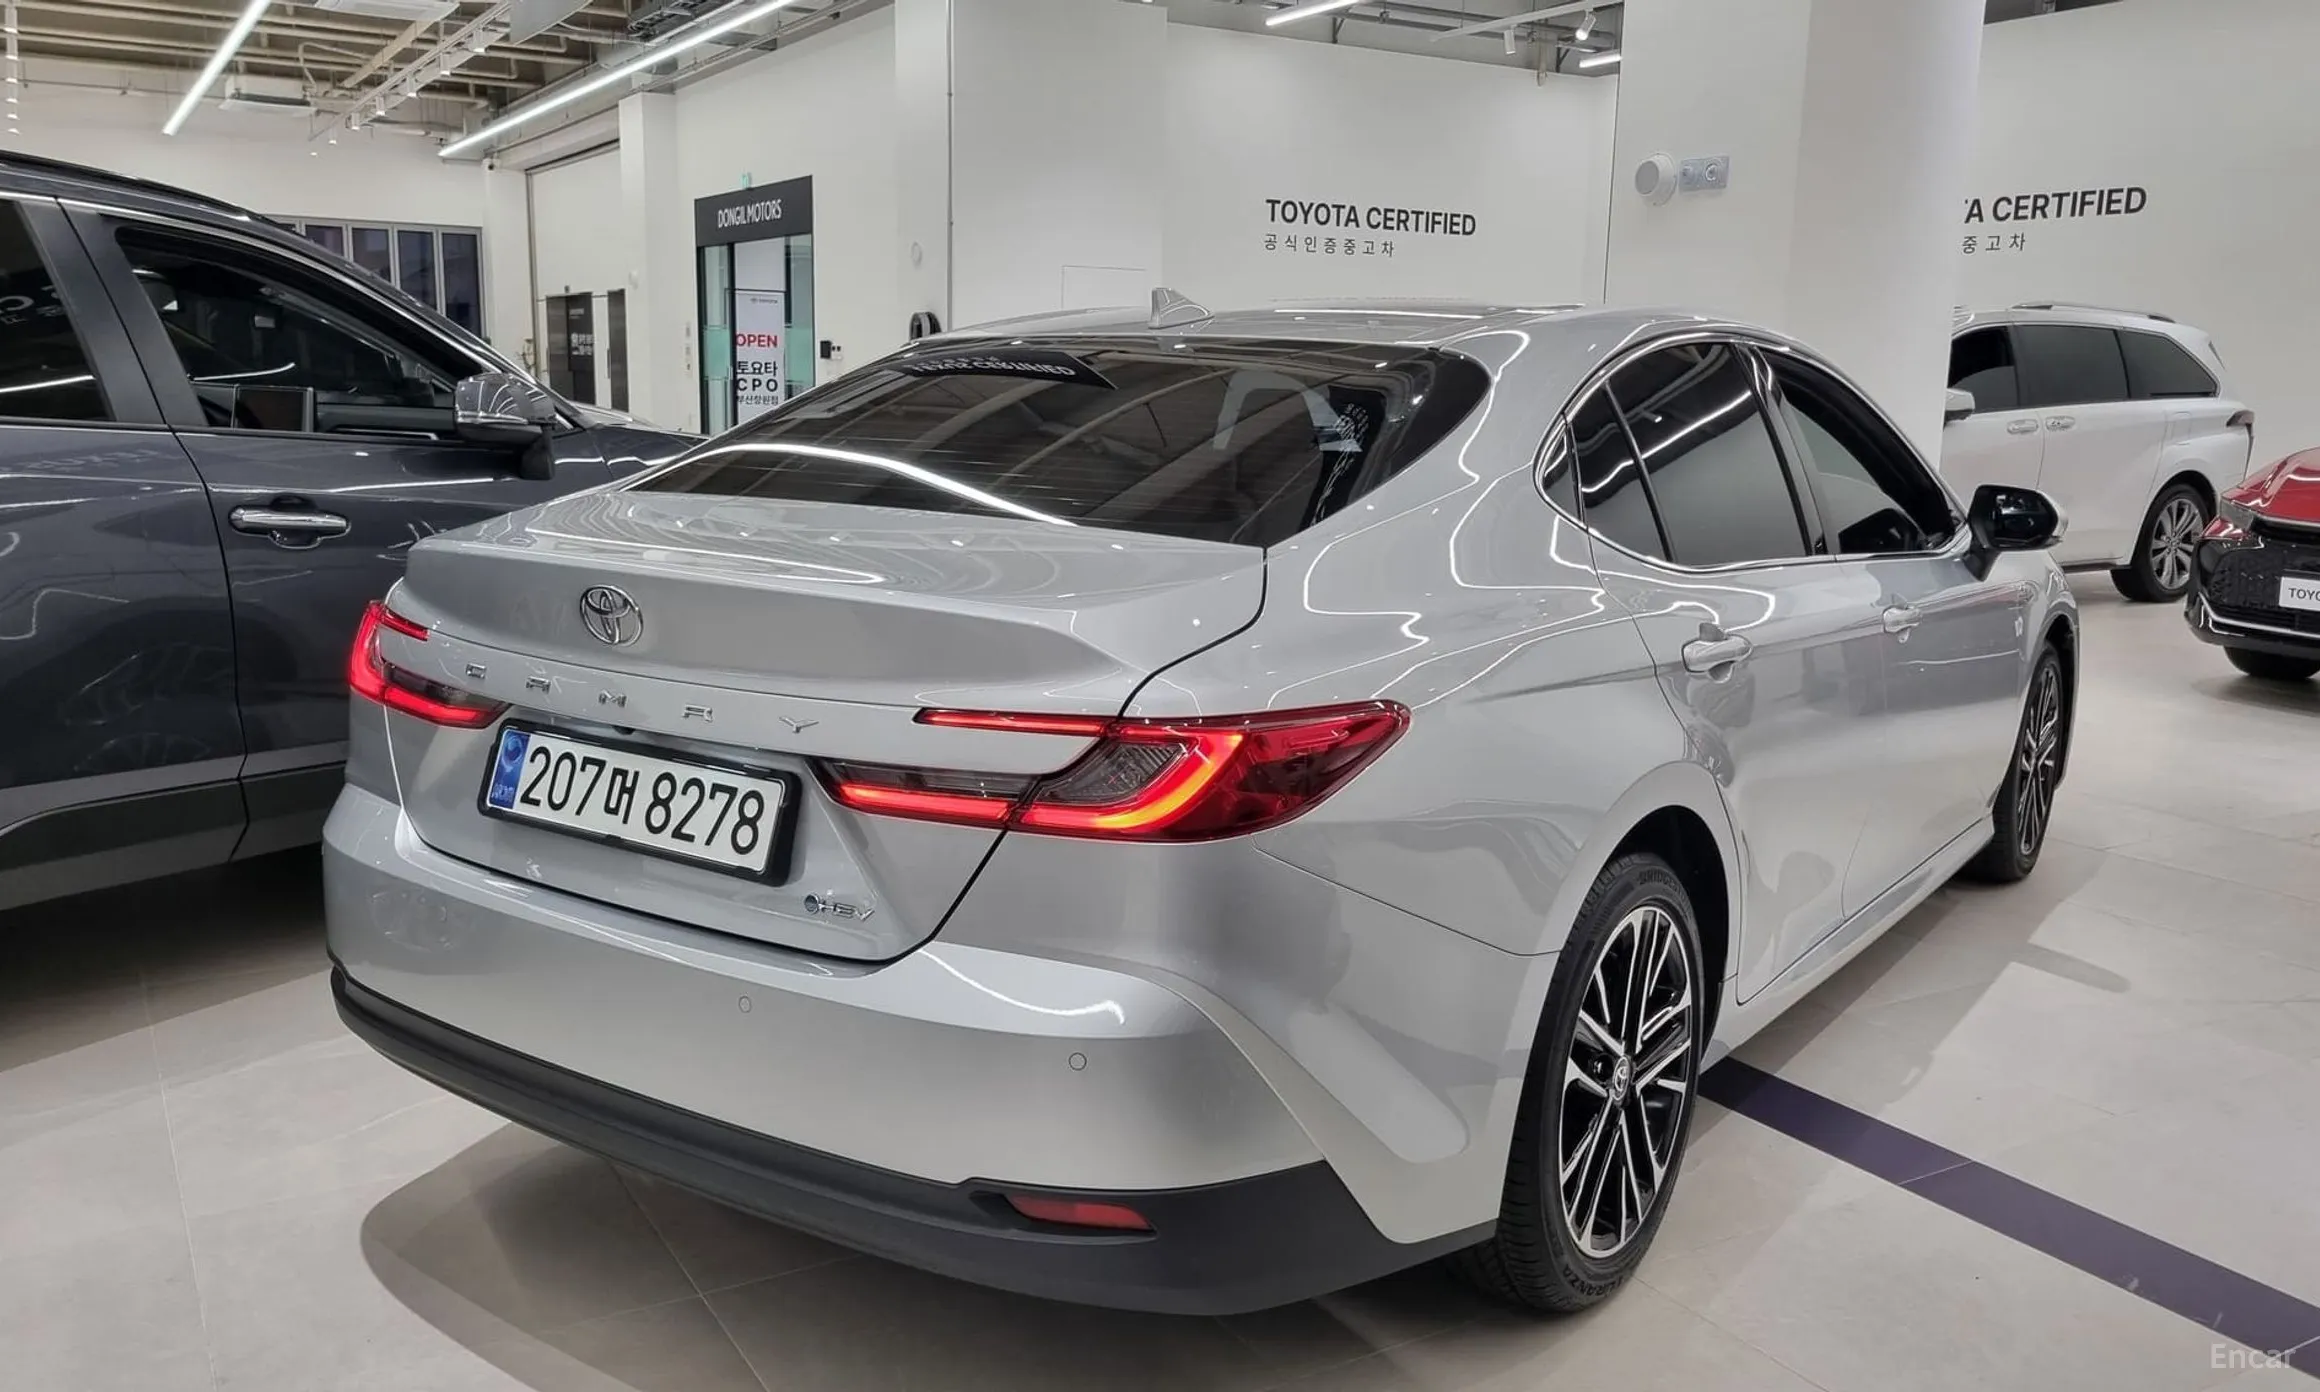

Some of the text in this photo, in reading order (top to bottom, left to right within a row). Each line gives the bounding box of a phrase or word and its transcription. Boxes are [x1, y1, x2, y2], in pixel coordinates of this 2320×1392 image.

[718, 199, 782, 228] DONGIL MOTORS
[1265, 198, 1476, 236] TOYOTA CERTIFIED
[1992, 186, 2147, 222] CERTIFIED
[736, 334, 778, 348] OPEN
[736, 360, 778, 377] 토요타
[465, 662, 820, 733] CAMRY
[645, 771, 764, 855] 8278
